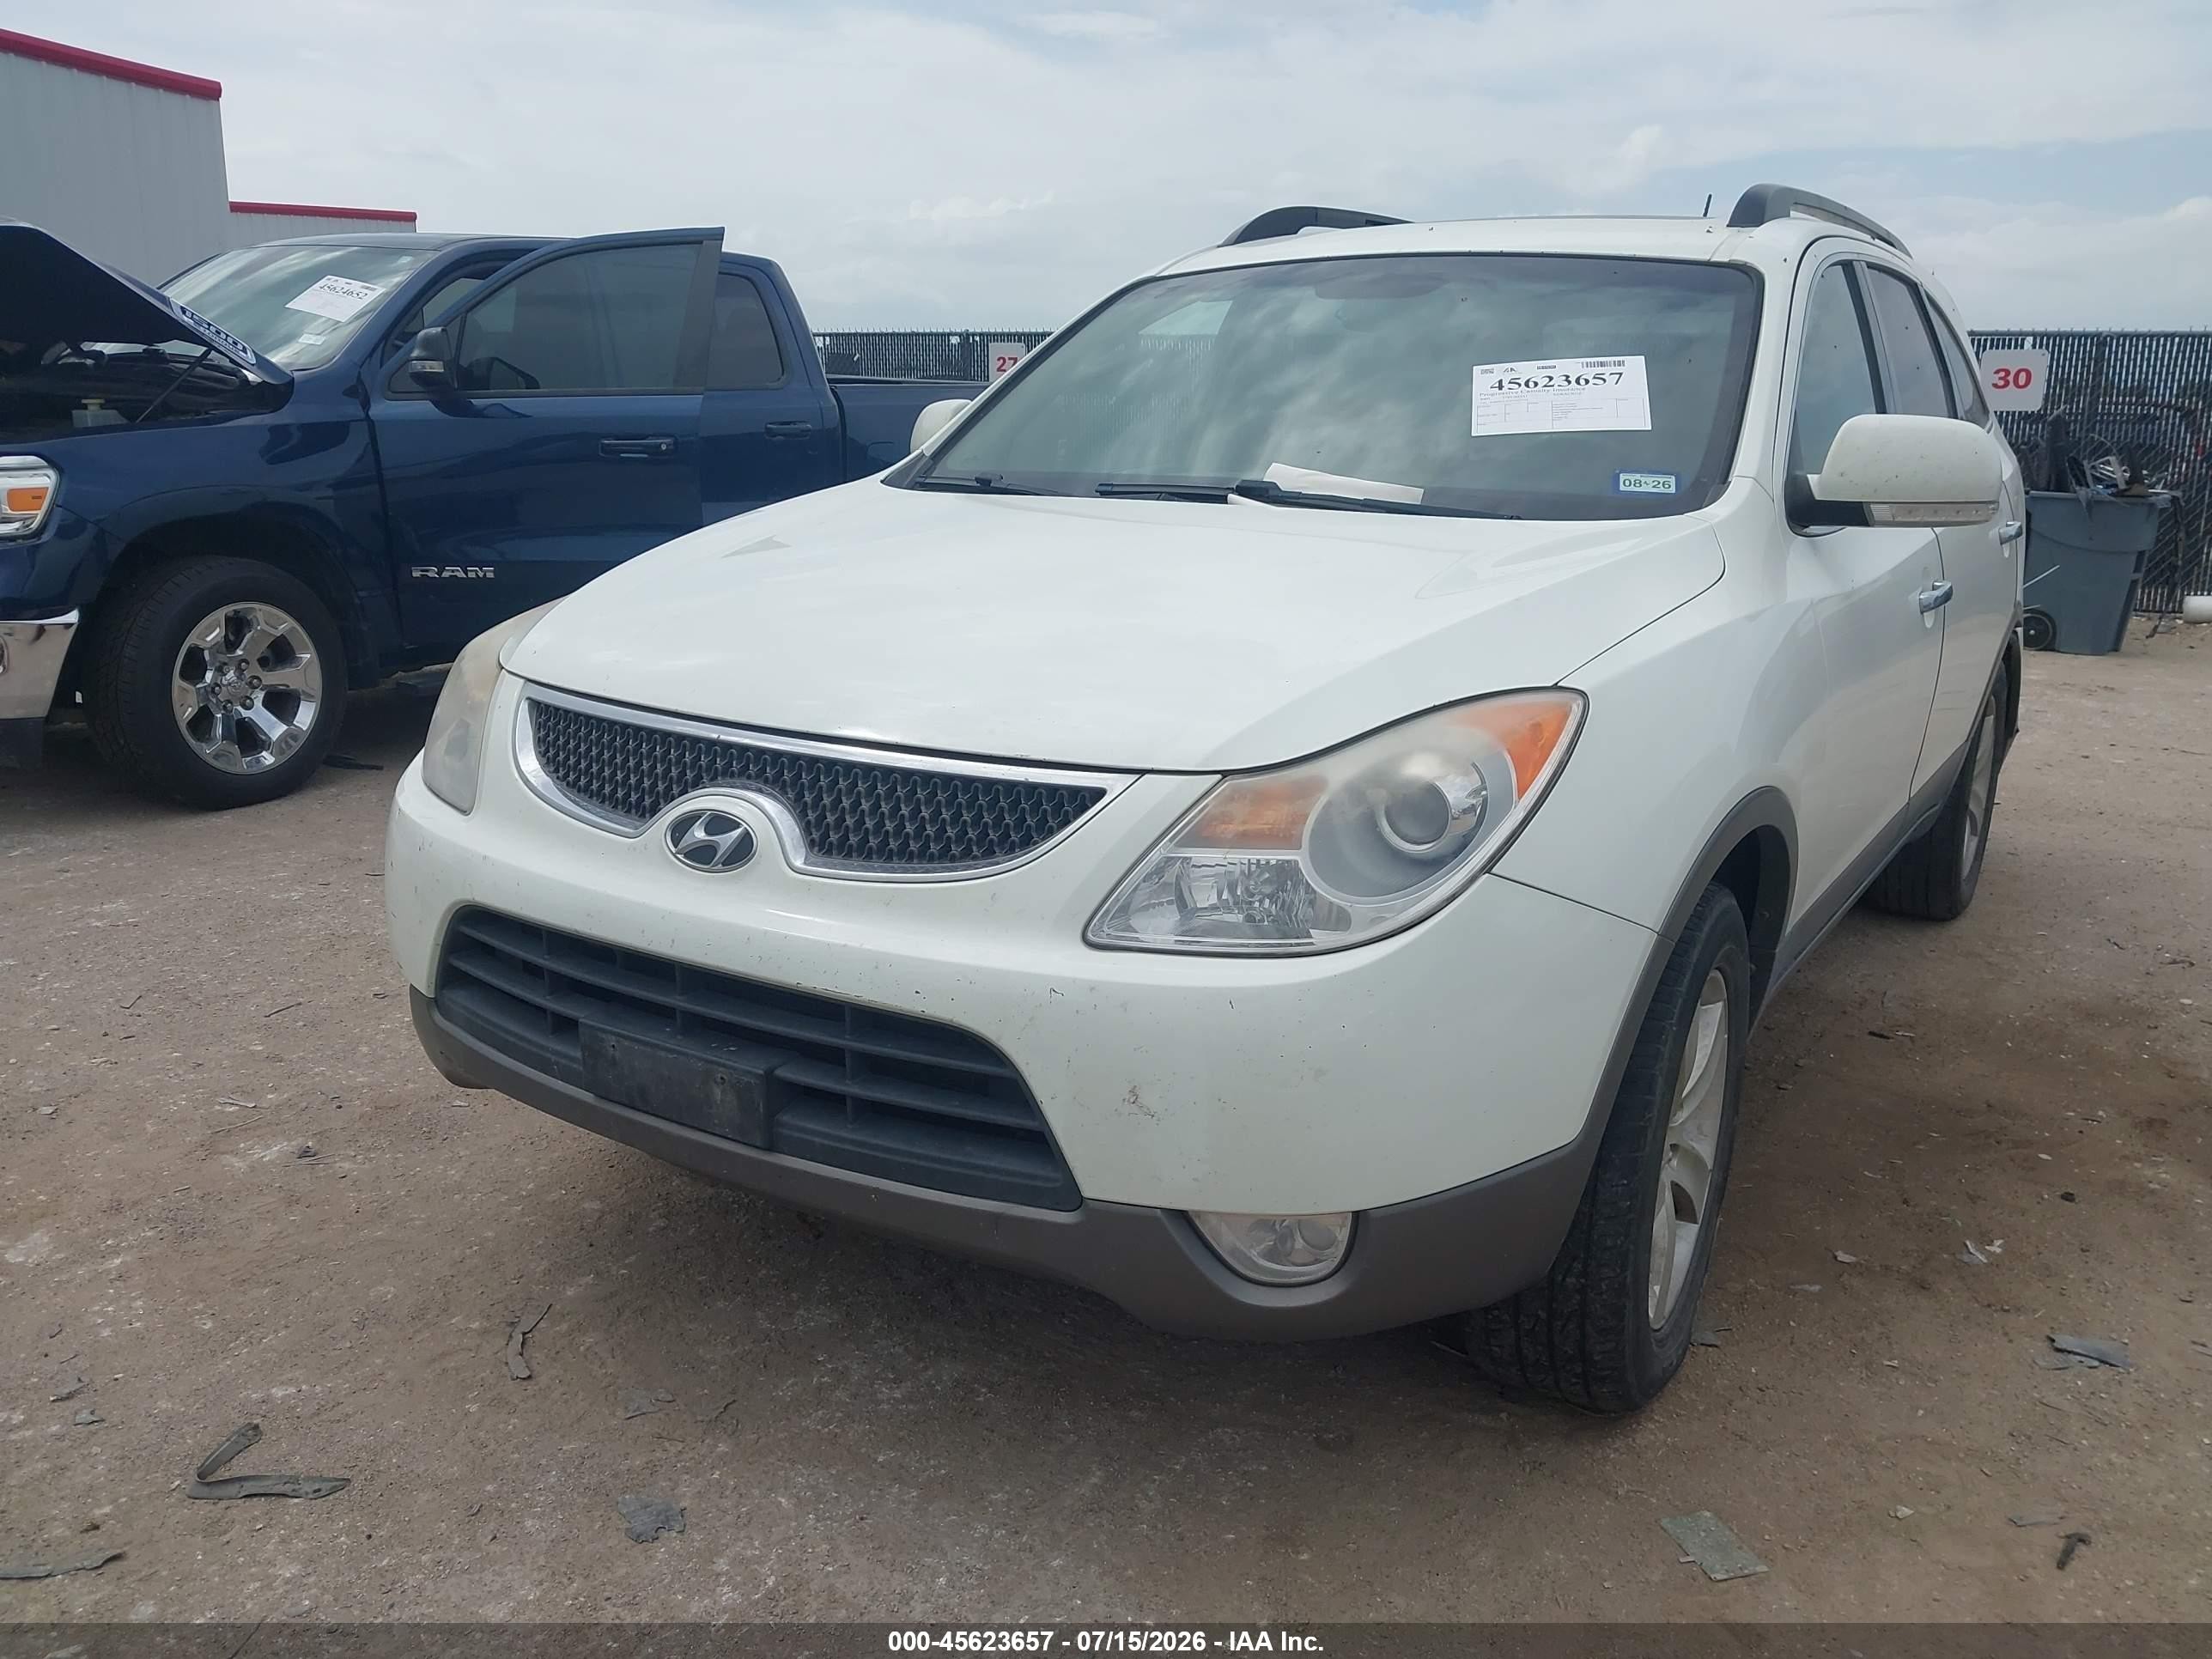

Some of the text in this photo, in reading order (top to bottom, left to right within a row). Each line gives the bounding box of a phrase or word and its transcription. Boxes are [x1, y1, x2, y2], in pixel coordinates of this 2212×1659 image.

[319, 283, 368, 300] 45624652
[184, 309, 244, 350] 1500
[997, 356, 1018, 372] 27
[1490, 373, 1624, 391] 45623657
[1992, 368, 2033, 389] 30
[1622, 478, 1672, 489] 08 26
[411, 567, 495, 578] RAM
